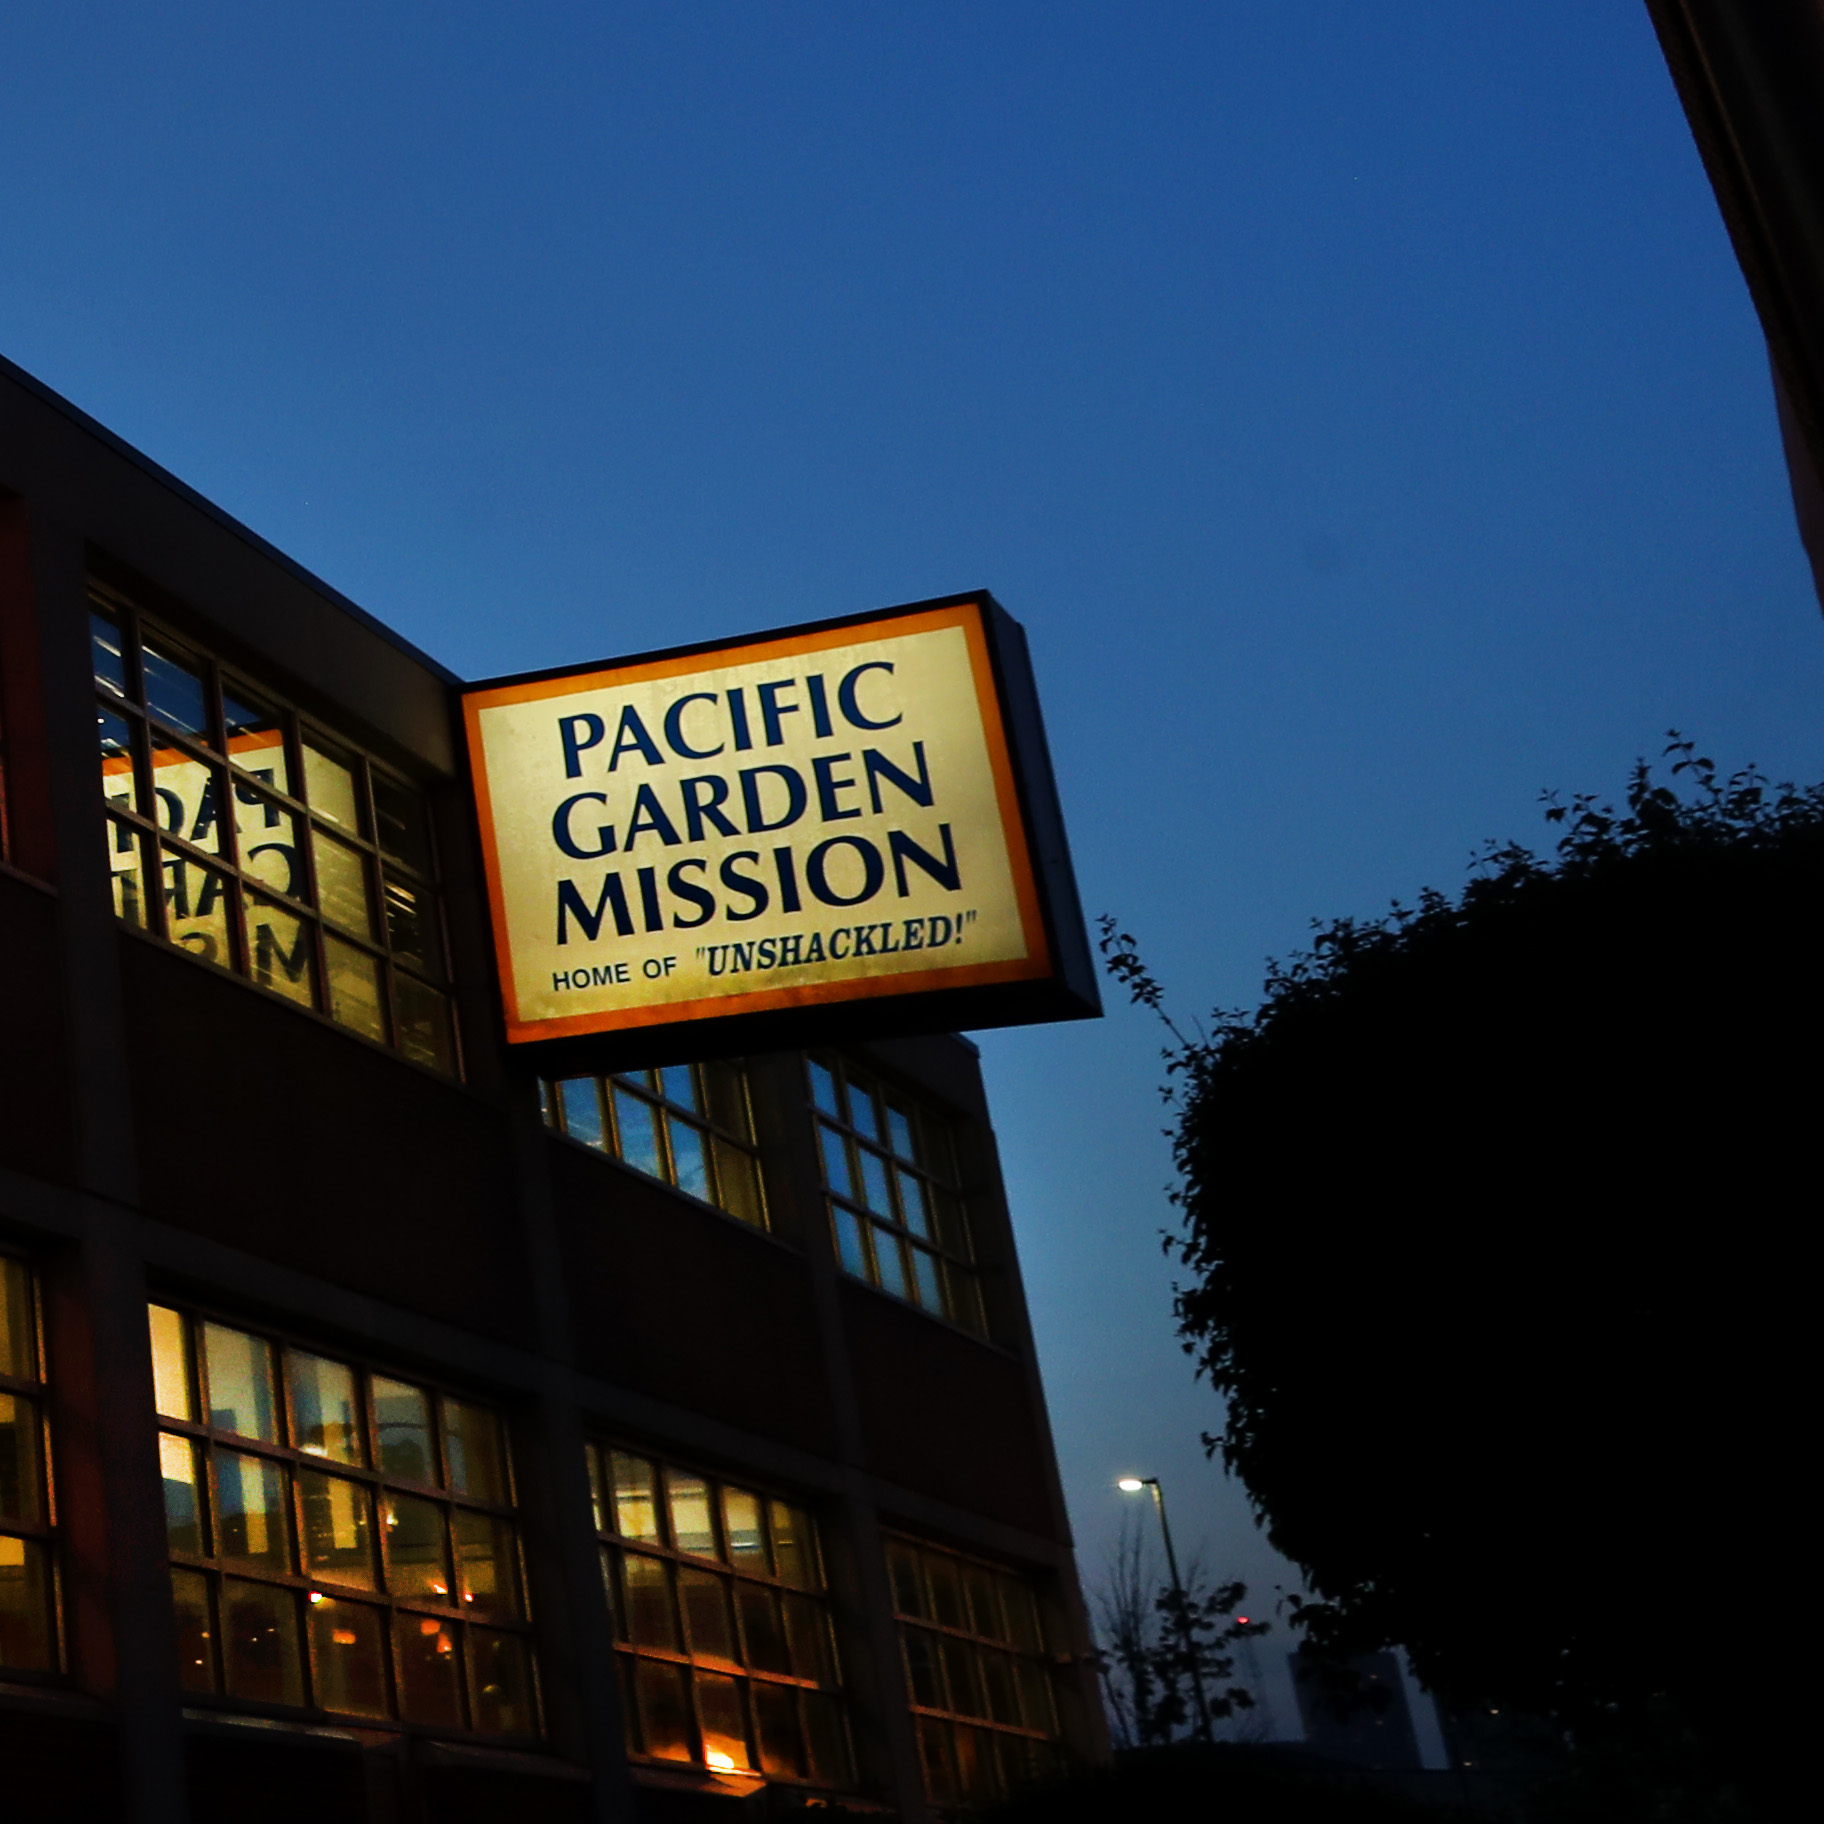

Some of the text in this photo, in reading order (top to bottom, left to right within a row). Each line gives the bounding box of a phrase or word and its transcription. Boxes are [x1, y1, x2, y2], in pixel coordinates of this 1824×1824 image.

[557, 660, 905, 780] PACIFIC
[551, 739, 936, 860] GARDEN
[555, 822, 963, 946] MISSION
[551, 909, 978, 992] HOME OF "UNSHACKLED!"
